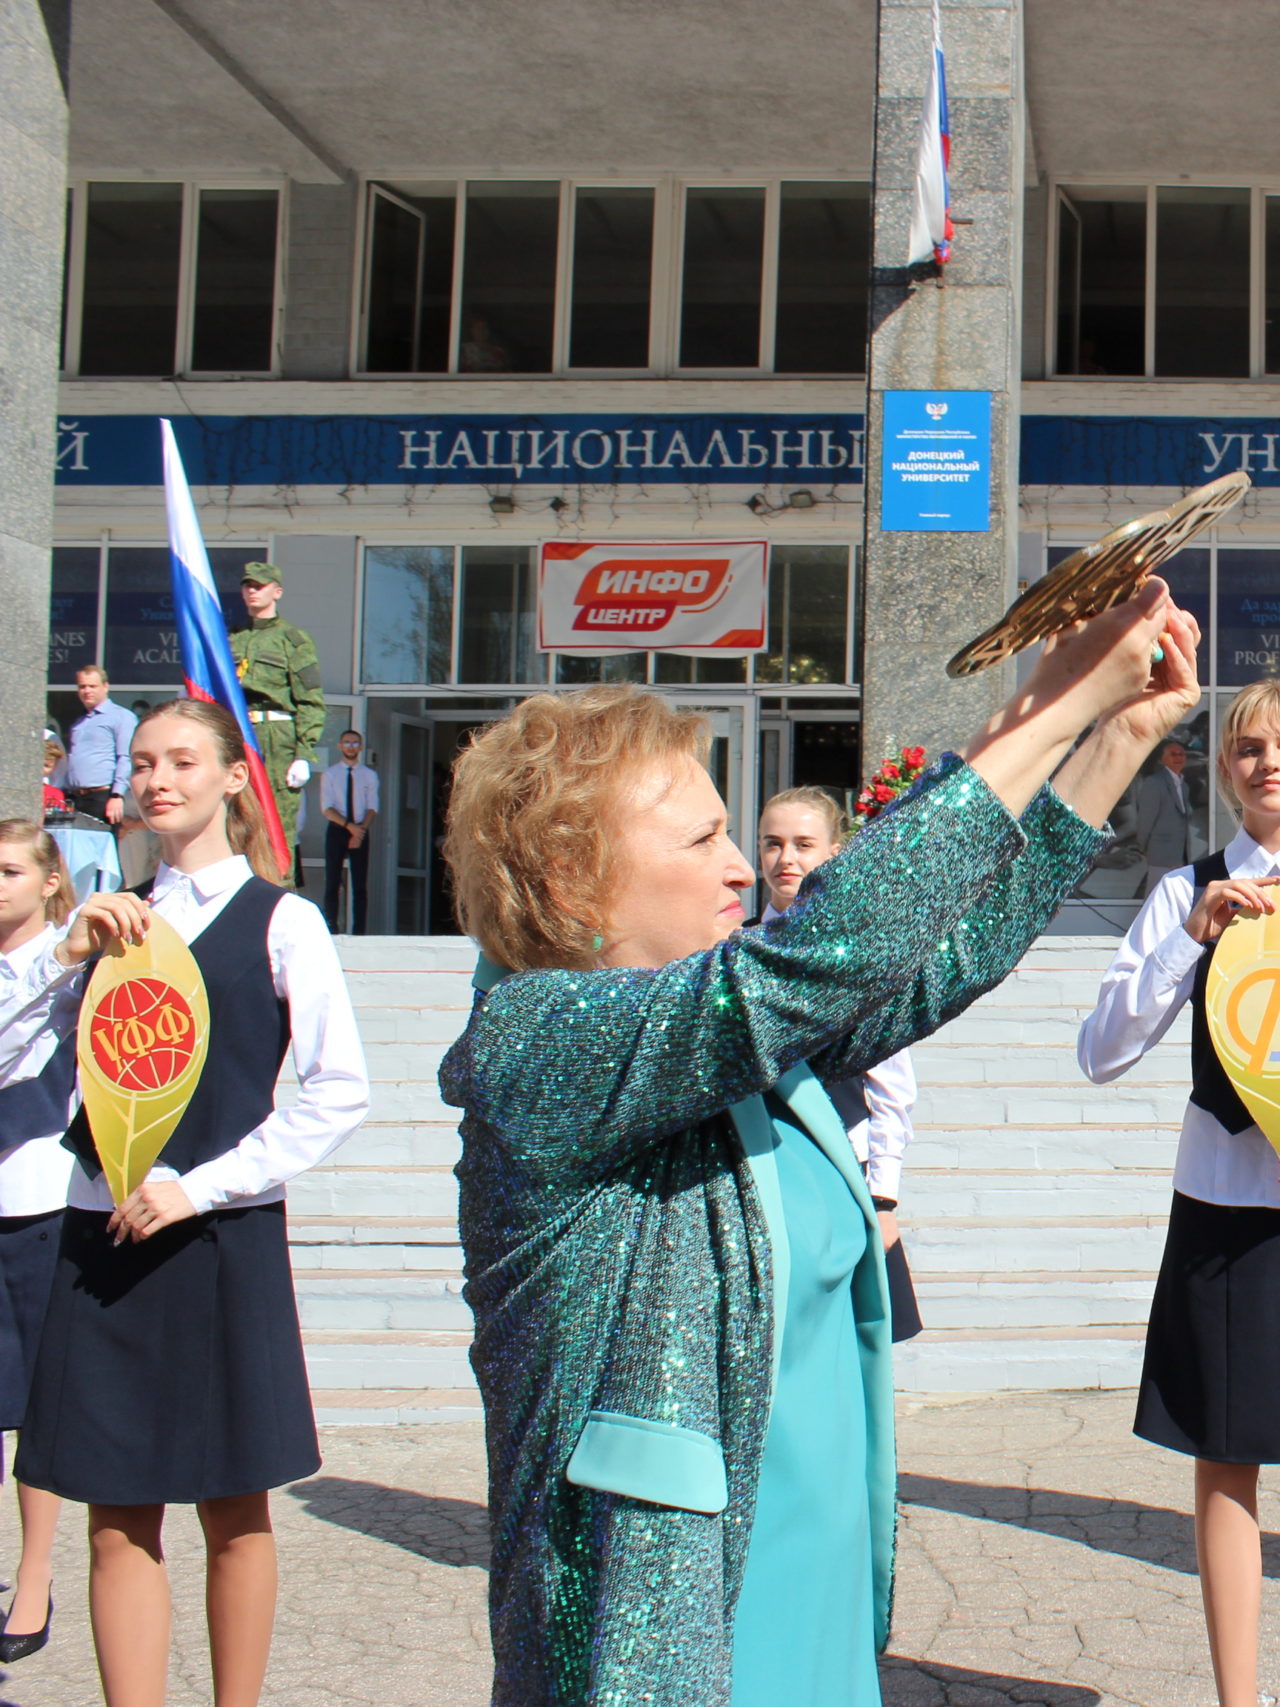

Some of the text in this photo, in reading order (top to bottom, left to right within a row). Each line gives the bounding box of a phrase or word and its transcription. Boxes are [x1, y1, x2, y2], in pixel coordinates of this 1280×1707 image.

[398, 429, 866, 479] НАЦИОНАЛЬНЫ
[908, 450, 964, 461] ДОНЕЦКИЙ
[892, 461, 979, 471] НАЦИОНАЛЬНЫЙ
[901, 473, 970, 482] УНИВЕРСИТЕТ
[596, 570, 710, 594] ИНФО
[1240, 598, 1260, 611] Да
[586, 609, 666, 624] ЦЕНТР
